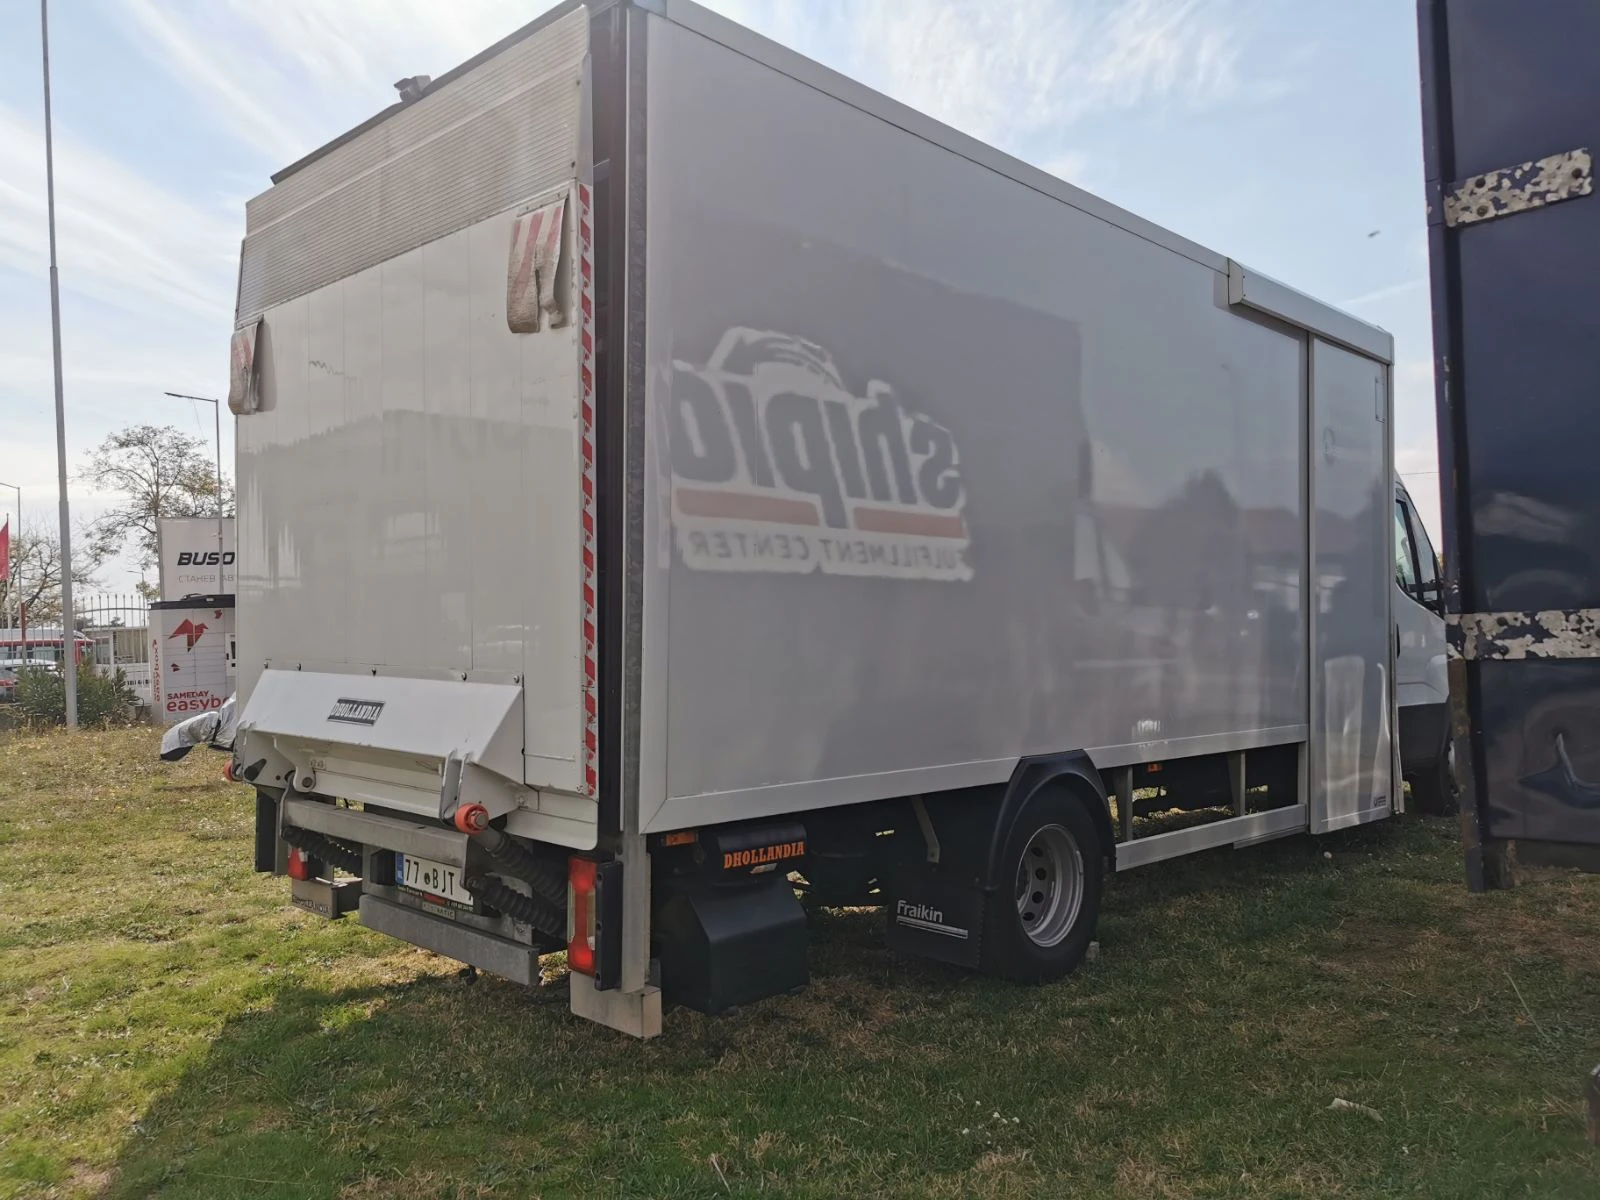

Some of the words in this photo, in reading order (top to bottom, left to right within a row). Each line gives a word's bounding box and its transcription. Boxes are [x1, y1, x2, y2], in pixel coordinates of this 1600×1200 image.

[167, 690, 209, 700] SAMEDAY
[723, 841, 805, 869] DHOLLANDIA
[896, 899, 943, 923] Fraikin
